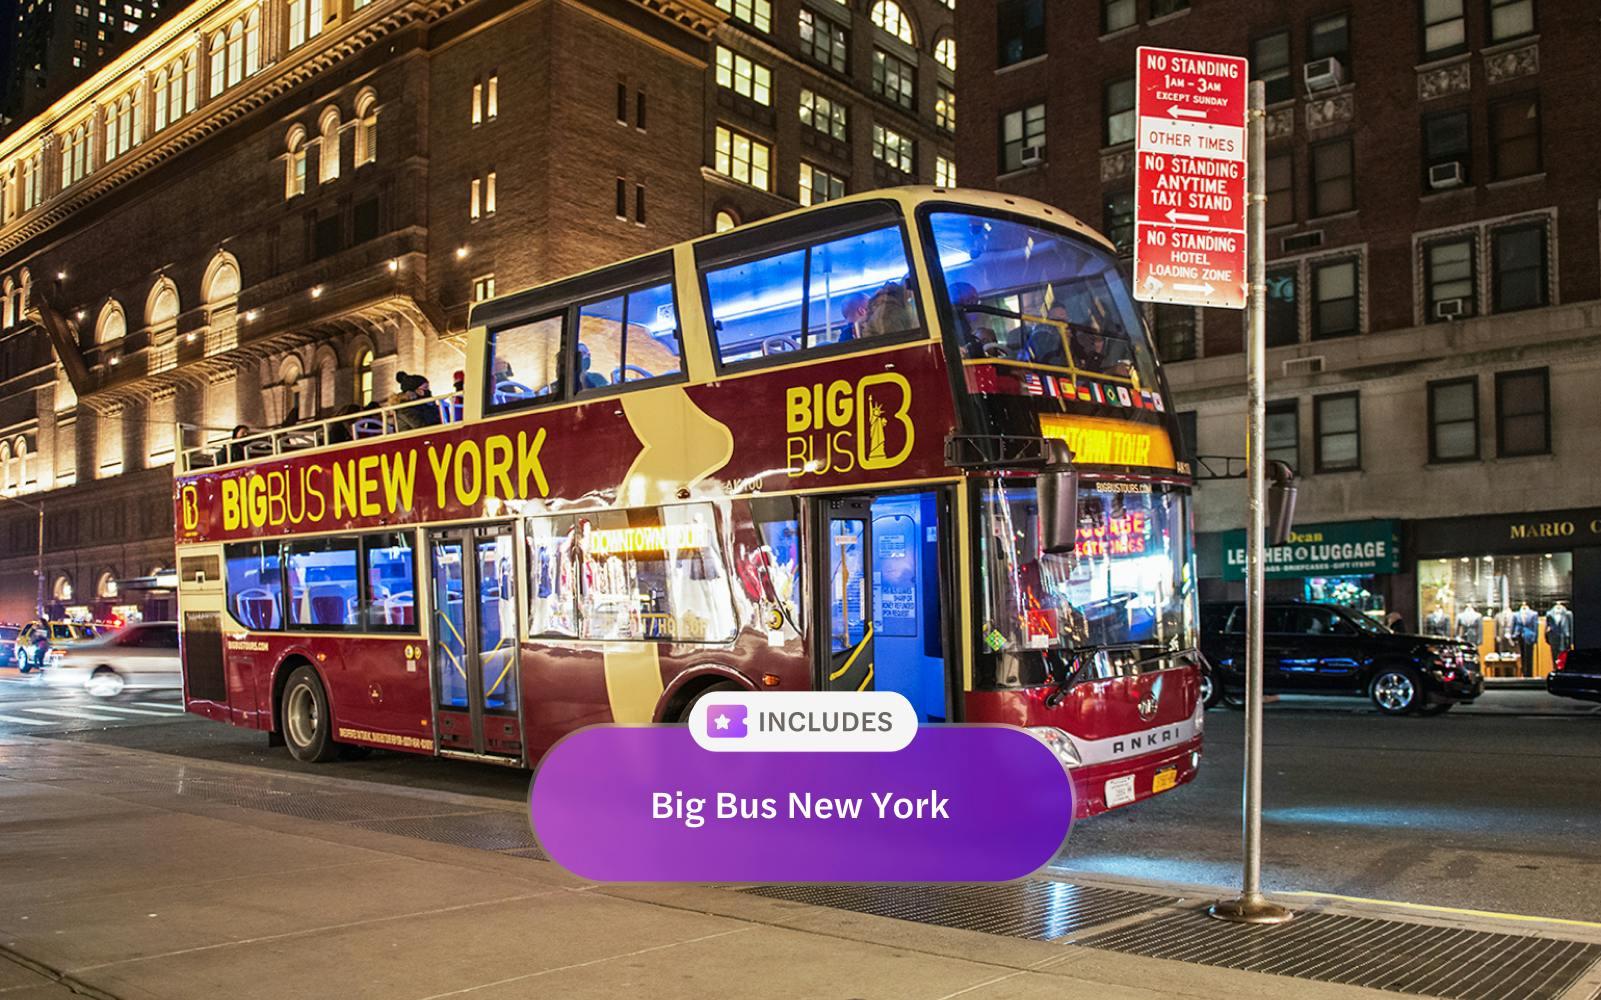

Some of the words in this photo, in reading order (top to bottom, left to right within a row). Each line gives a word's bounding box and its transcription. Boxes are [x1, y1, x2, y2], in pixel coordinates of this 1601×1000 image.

[1147, 54, 1166, 71] NO
[1171, 57, 1238, 79] STANDING
[1164, 74, 1185, 89] 1AM
[1197, 78, 1221, 93] 3AM
[1156, 91, 1190, 102] EXCEPT
[1193, 95, 1228, 107] SUNDAY
[1150, 131, 1191, 147] OTHER
[1198, 136, 1234, 152] TIMES
[1145, 155, 1164, 171] NO
[1171, 158, 1238, 179] STANDING
[1157, 174, 1227, 195] ANYTIME
[1151, 189, 1182, 207] TAXI
[1189, 193, 1232, 211] STAND
[1147, 230, 1166, 247] NO
[1172, 233, 1236, 253] STANDING
[1171, 251, 1210, 265] HOTEL
[1149, 263, 1198, 279] LOADING
[1202, 269, 1232, 281] ZONE
[786, 379, 854, 433] BIG
[786, 430, 855, 478] BUS
[333, 449, 418, 520] NEW
[427, 427, 550, 509] YORK
[1287, 531, 1323, 543] Dean
[1510, 521, 1575, 539] MARIO
[1228, 546, 1293, 565] LEHER
[1311, 541, 1386, 561] LUGGAGE
[1113, 728, 1179, 754] ANKAI
